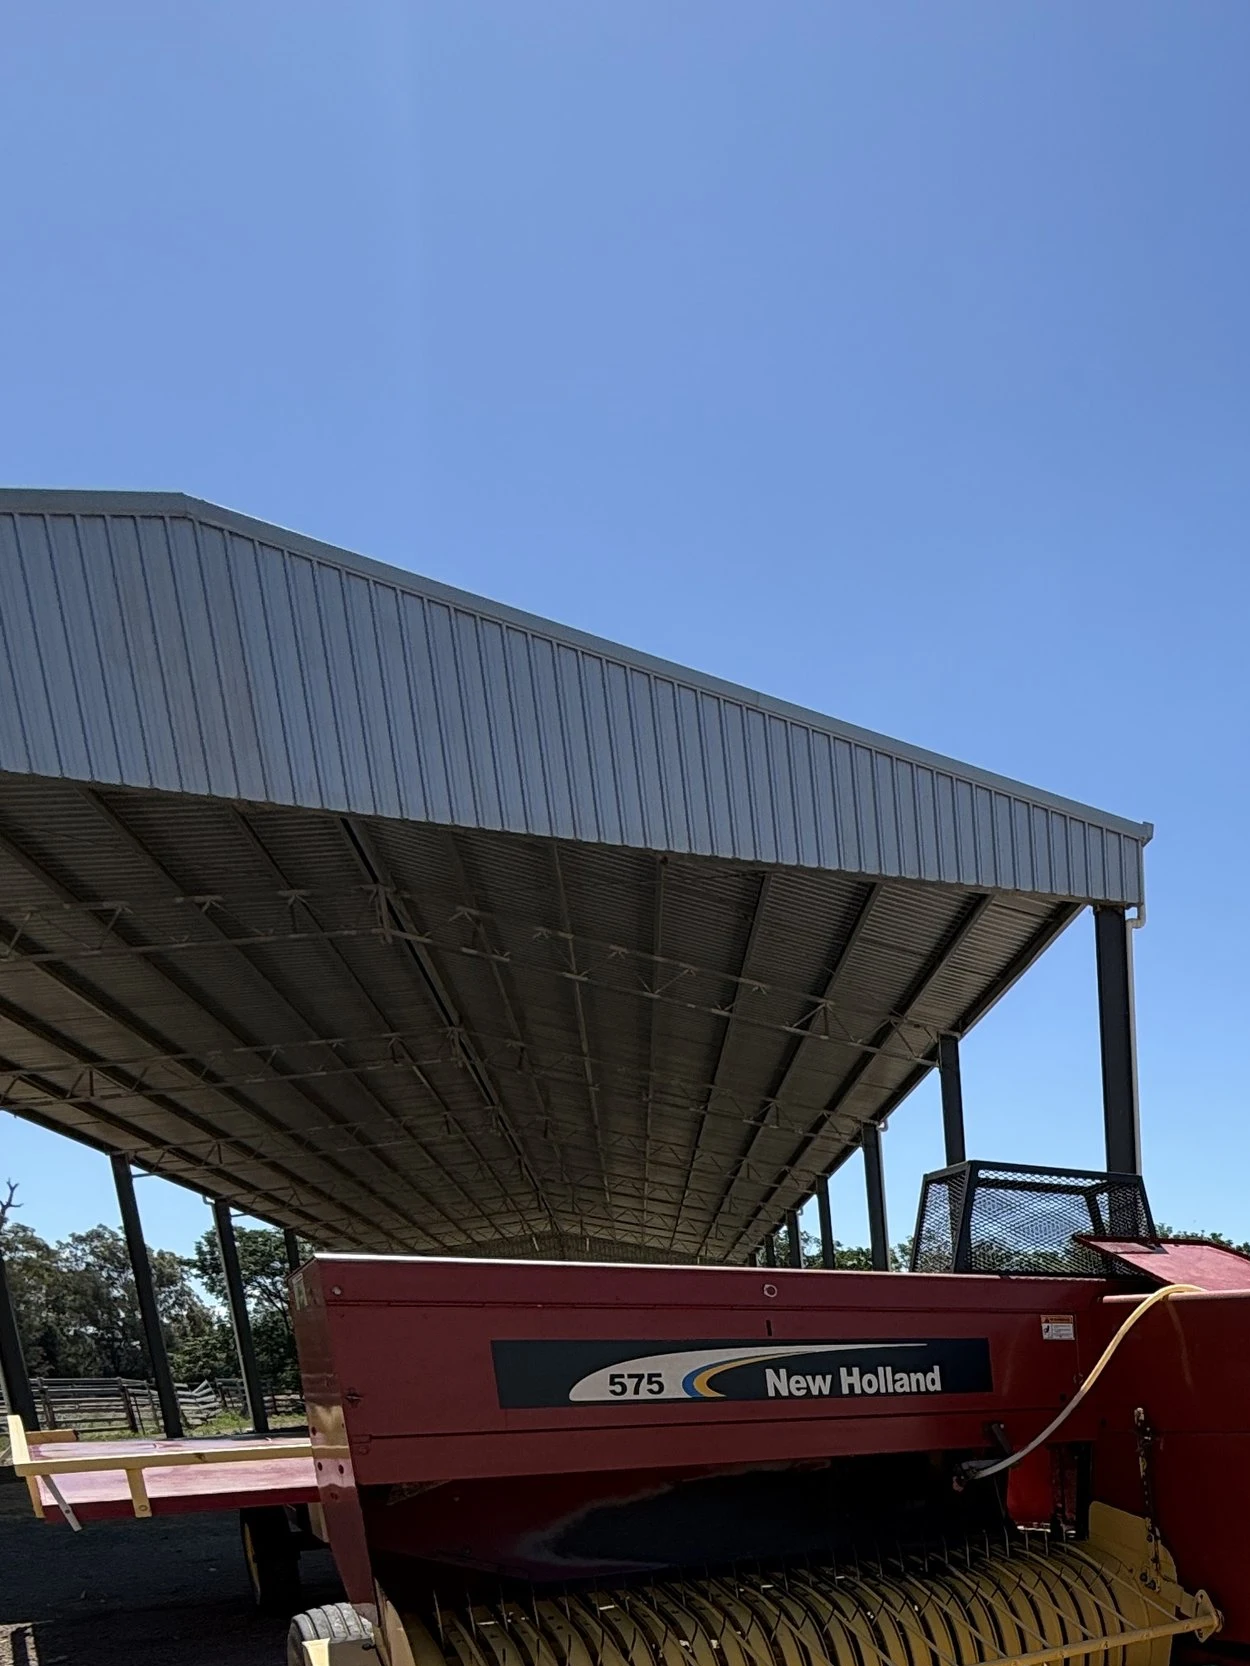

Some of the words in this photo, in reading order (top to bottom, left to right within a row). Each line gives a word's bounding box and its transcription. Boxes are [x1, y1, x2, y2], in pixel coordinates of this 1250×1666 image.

[609, 1373, 664, 1396] 575
[765, 1368, 832, 1397] New
[839, 1365, 941, 1394] Holland
